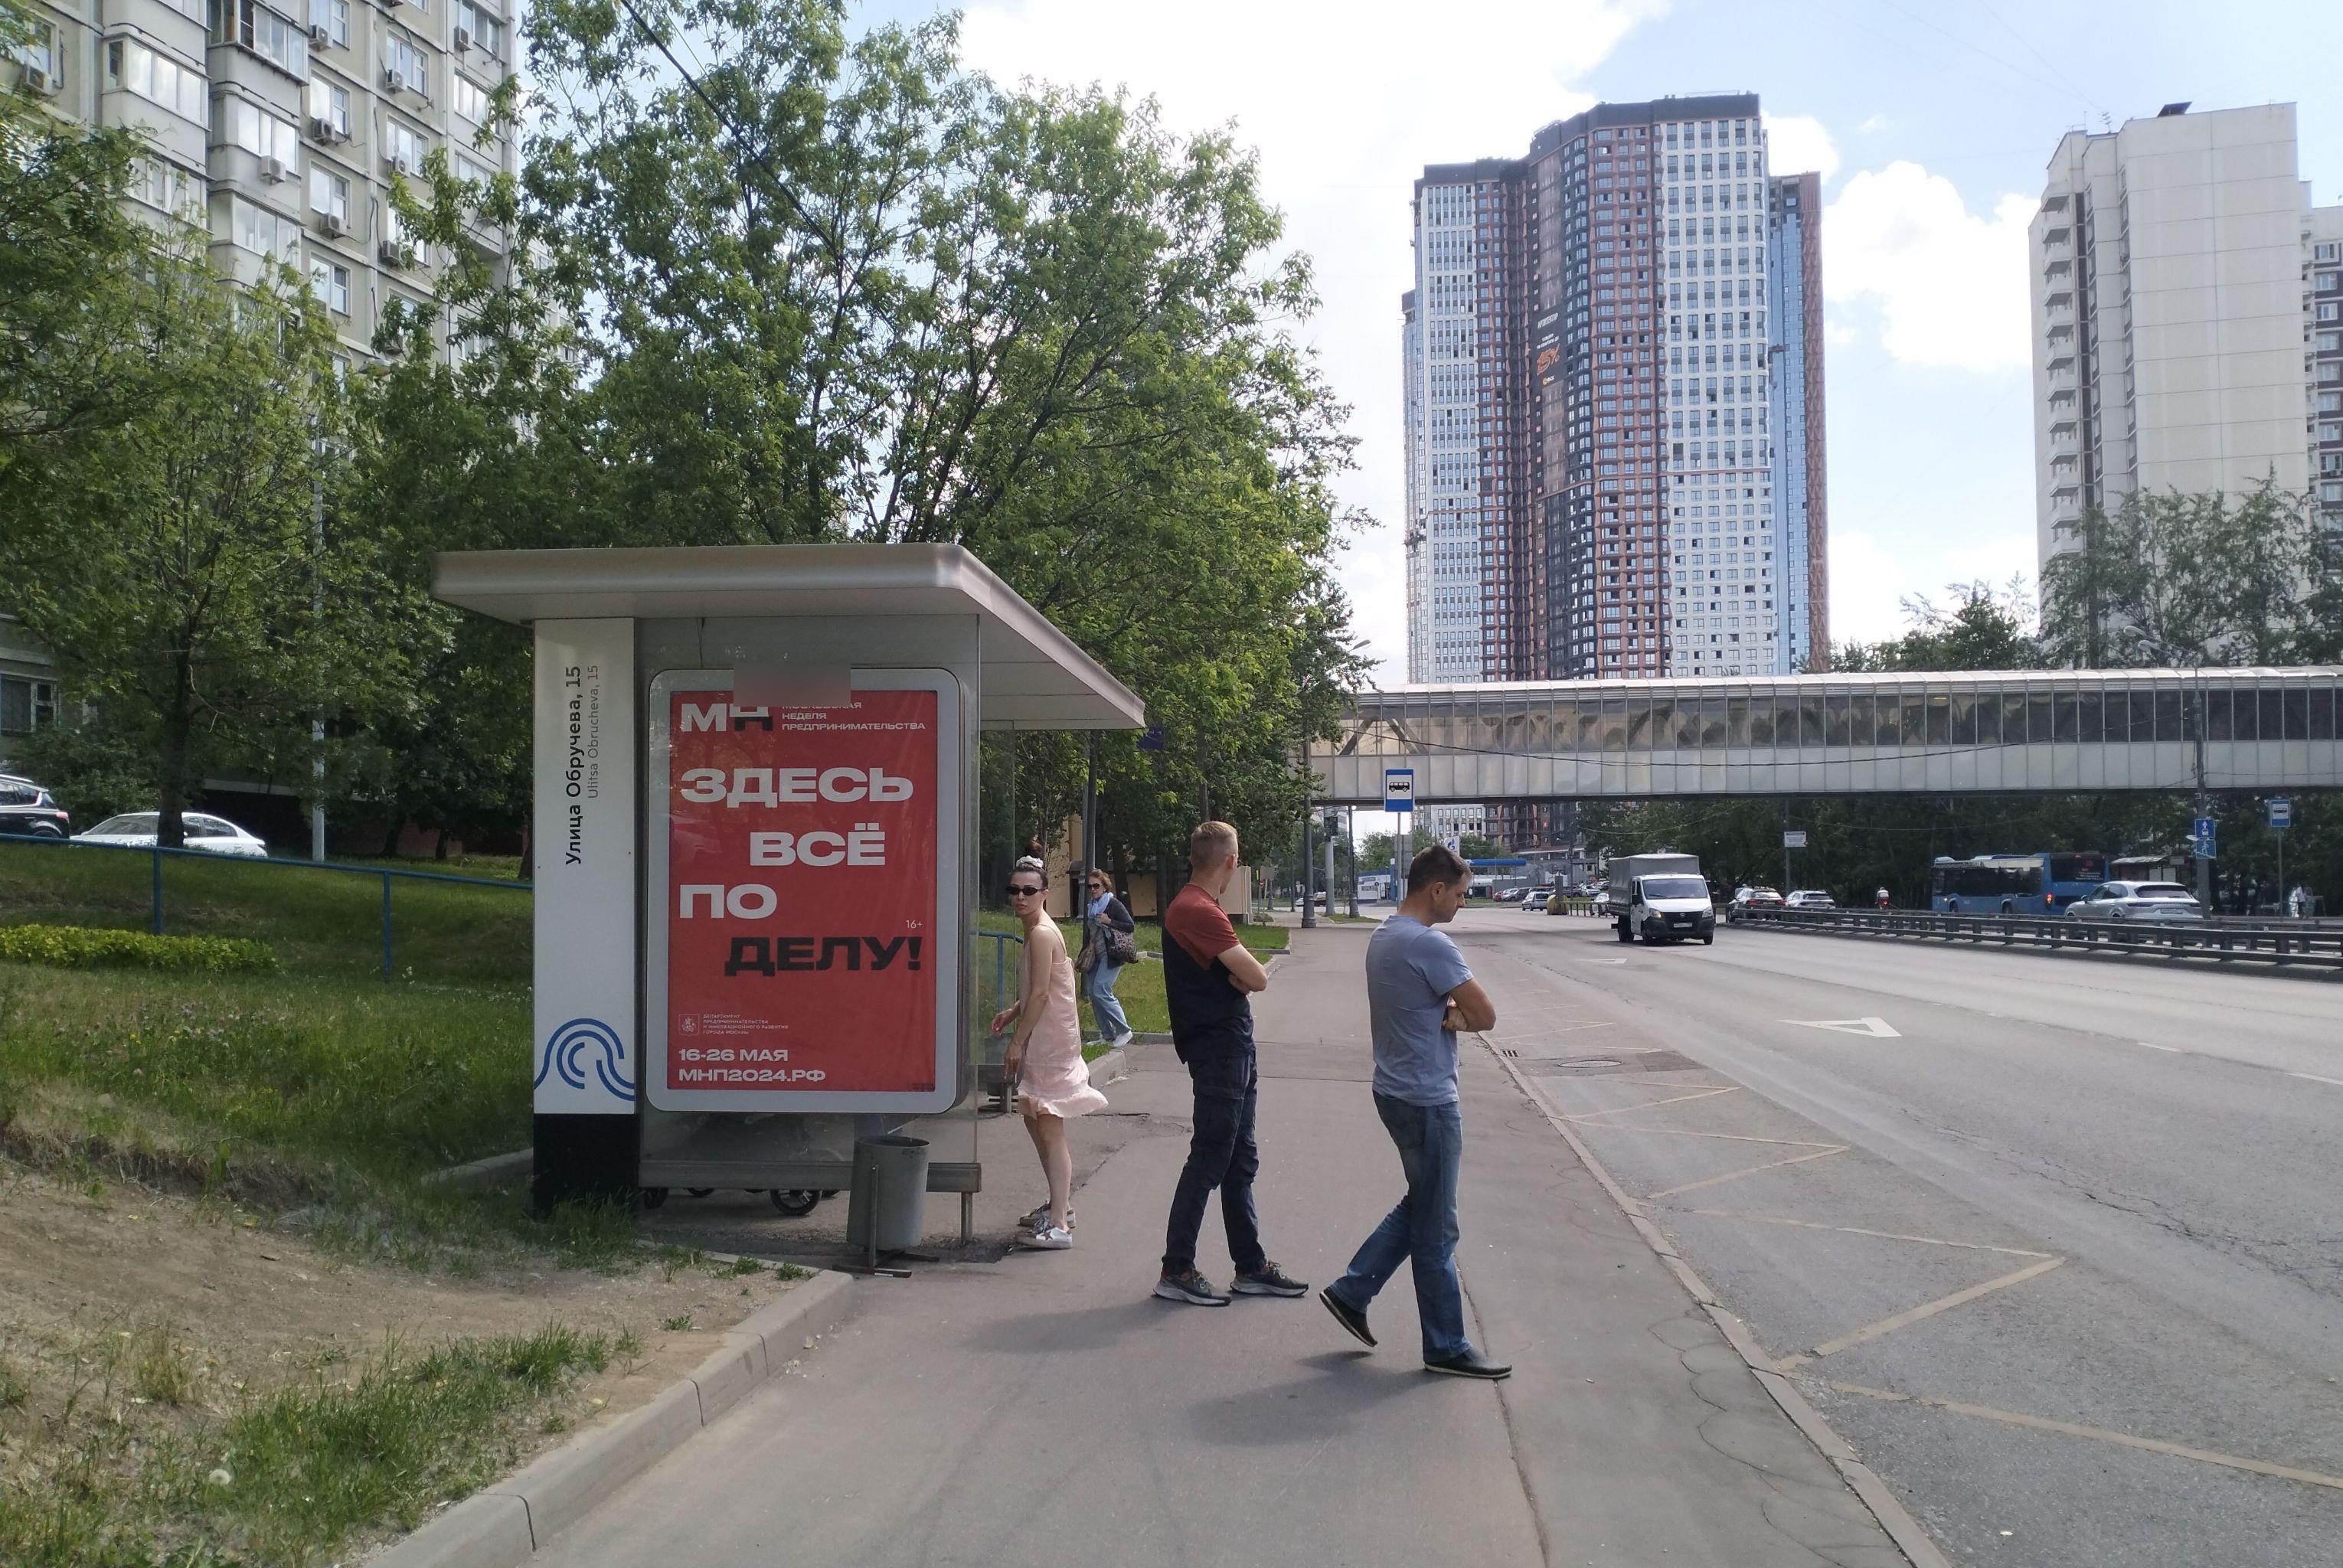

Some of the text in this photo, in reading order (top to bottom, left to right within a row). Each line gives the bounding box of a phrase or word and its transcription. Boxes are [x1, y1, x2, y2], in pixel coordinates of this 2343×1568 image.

[587, 665, 600, 799] Ulitsa Obrucheva, 15
[782, 712, 827, 720] НЕДЕЛЯ
[782, 722, 926, 731] ПРЕДПРИНИМАТЕЛЬСТВА
[565, 665, 584, 865] Улица Обручева, 15
[681, 767, 913, 808] ЗДЕСЬ
[750, 822, 886, 866] ВСЁ
[679, 884, 777, 919] ПО
[906, 920, 923, 929] 16+
[724, 936, 923, 976] ДЕЛУ!
[678, 1048, 789, 1062] 16-26 МАЯ
[678, 1069, 826, 1083] МНП2024.РФ
